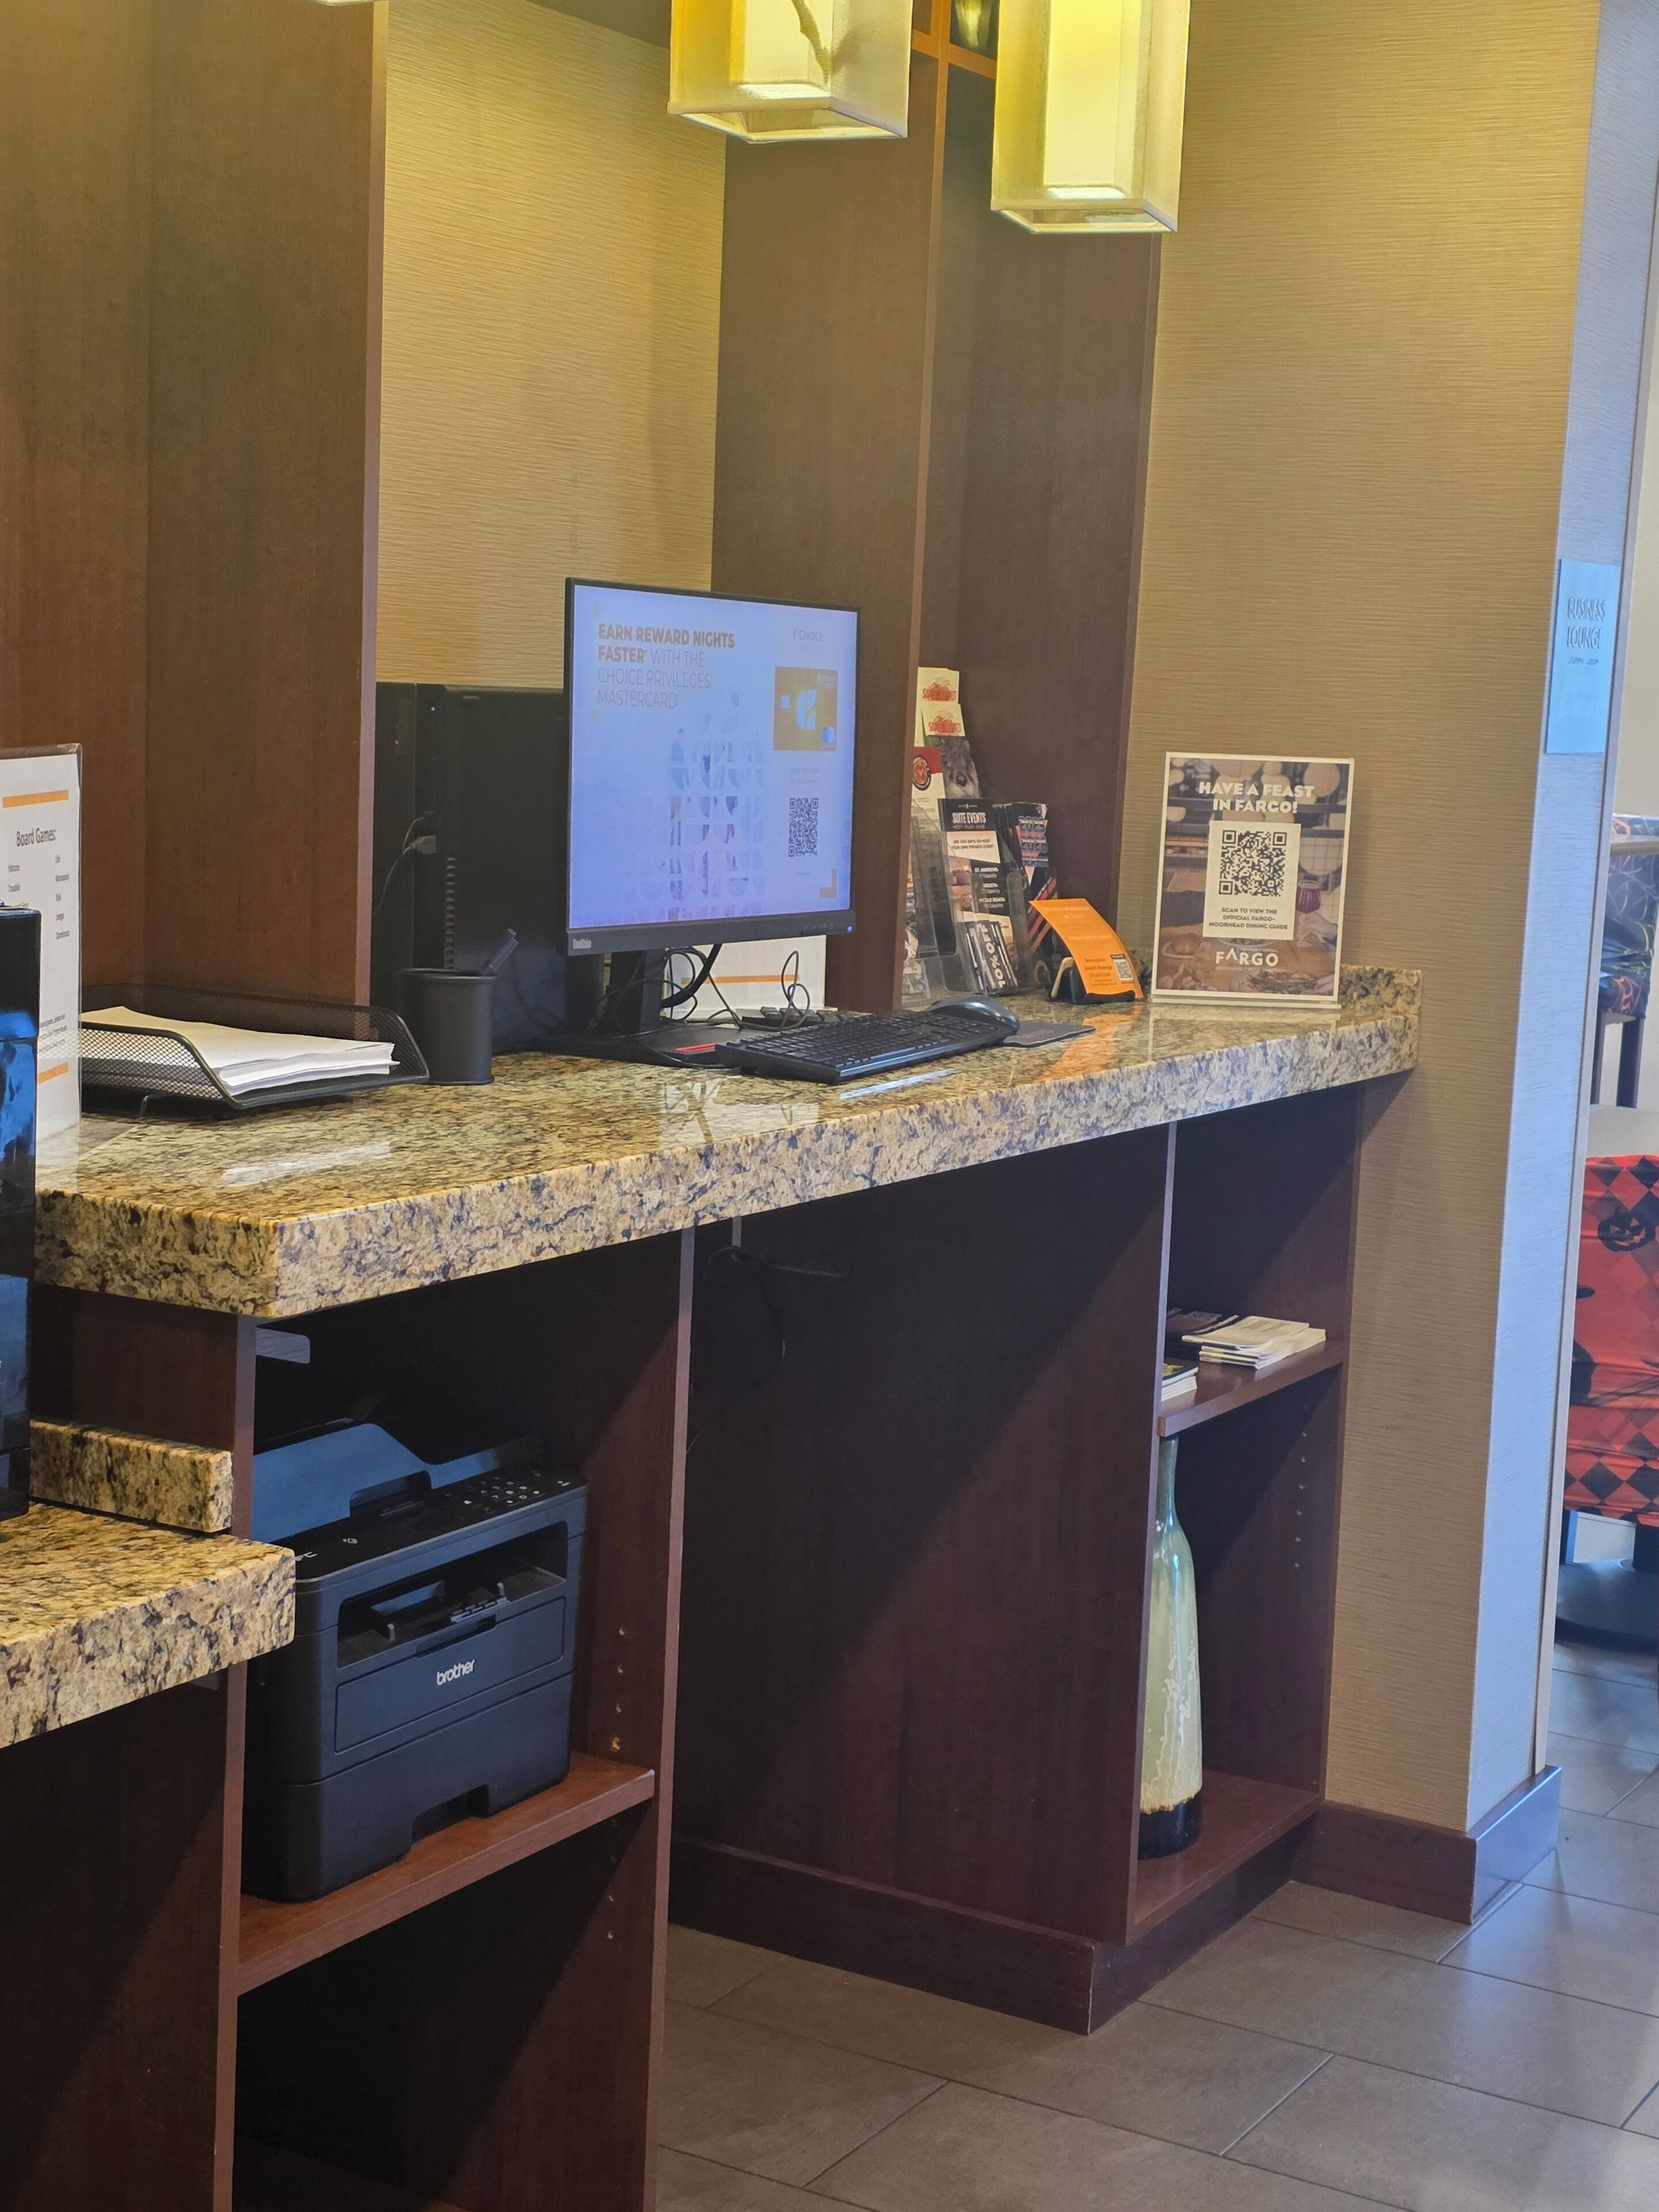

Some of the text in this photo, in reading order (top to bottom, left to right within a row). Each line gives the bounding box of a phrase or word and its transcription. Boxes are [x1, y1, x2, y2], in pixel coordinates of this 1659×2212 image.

[1567, 597, 1607, 622] BUSINESS
[599, 623, 735, 649] EARN REWARD NIGHTS
[800, 630, 823, 642] CHOICE
[1567, 626, 1603, 649] LOUNGE
[651, 649, 680, 666] WITH
[685, 651, 705, 668] THE
[597, 667, 711, 689] CHOICE PRIVILEGES
[597, 690, 677, 709] MASTERCARD
[1199, 782, 1315, 798] HAVE A FEAST
[1213, 798, 1298, 814] IN FARGO!
[952, 812, 987, 824] SUITE EVENTS
[17, 828, 34, 847] Board
[978, 923, 995, 954] OFF
[1215, 947, 1279, 967] FARGO
[990, 955, 1006, 988] 10%
[436, 1659, 475, 1686] brother
